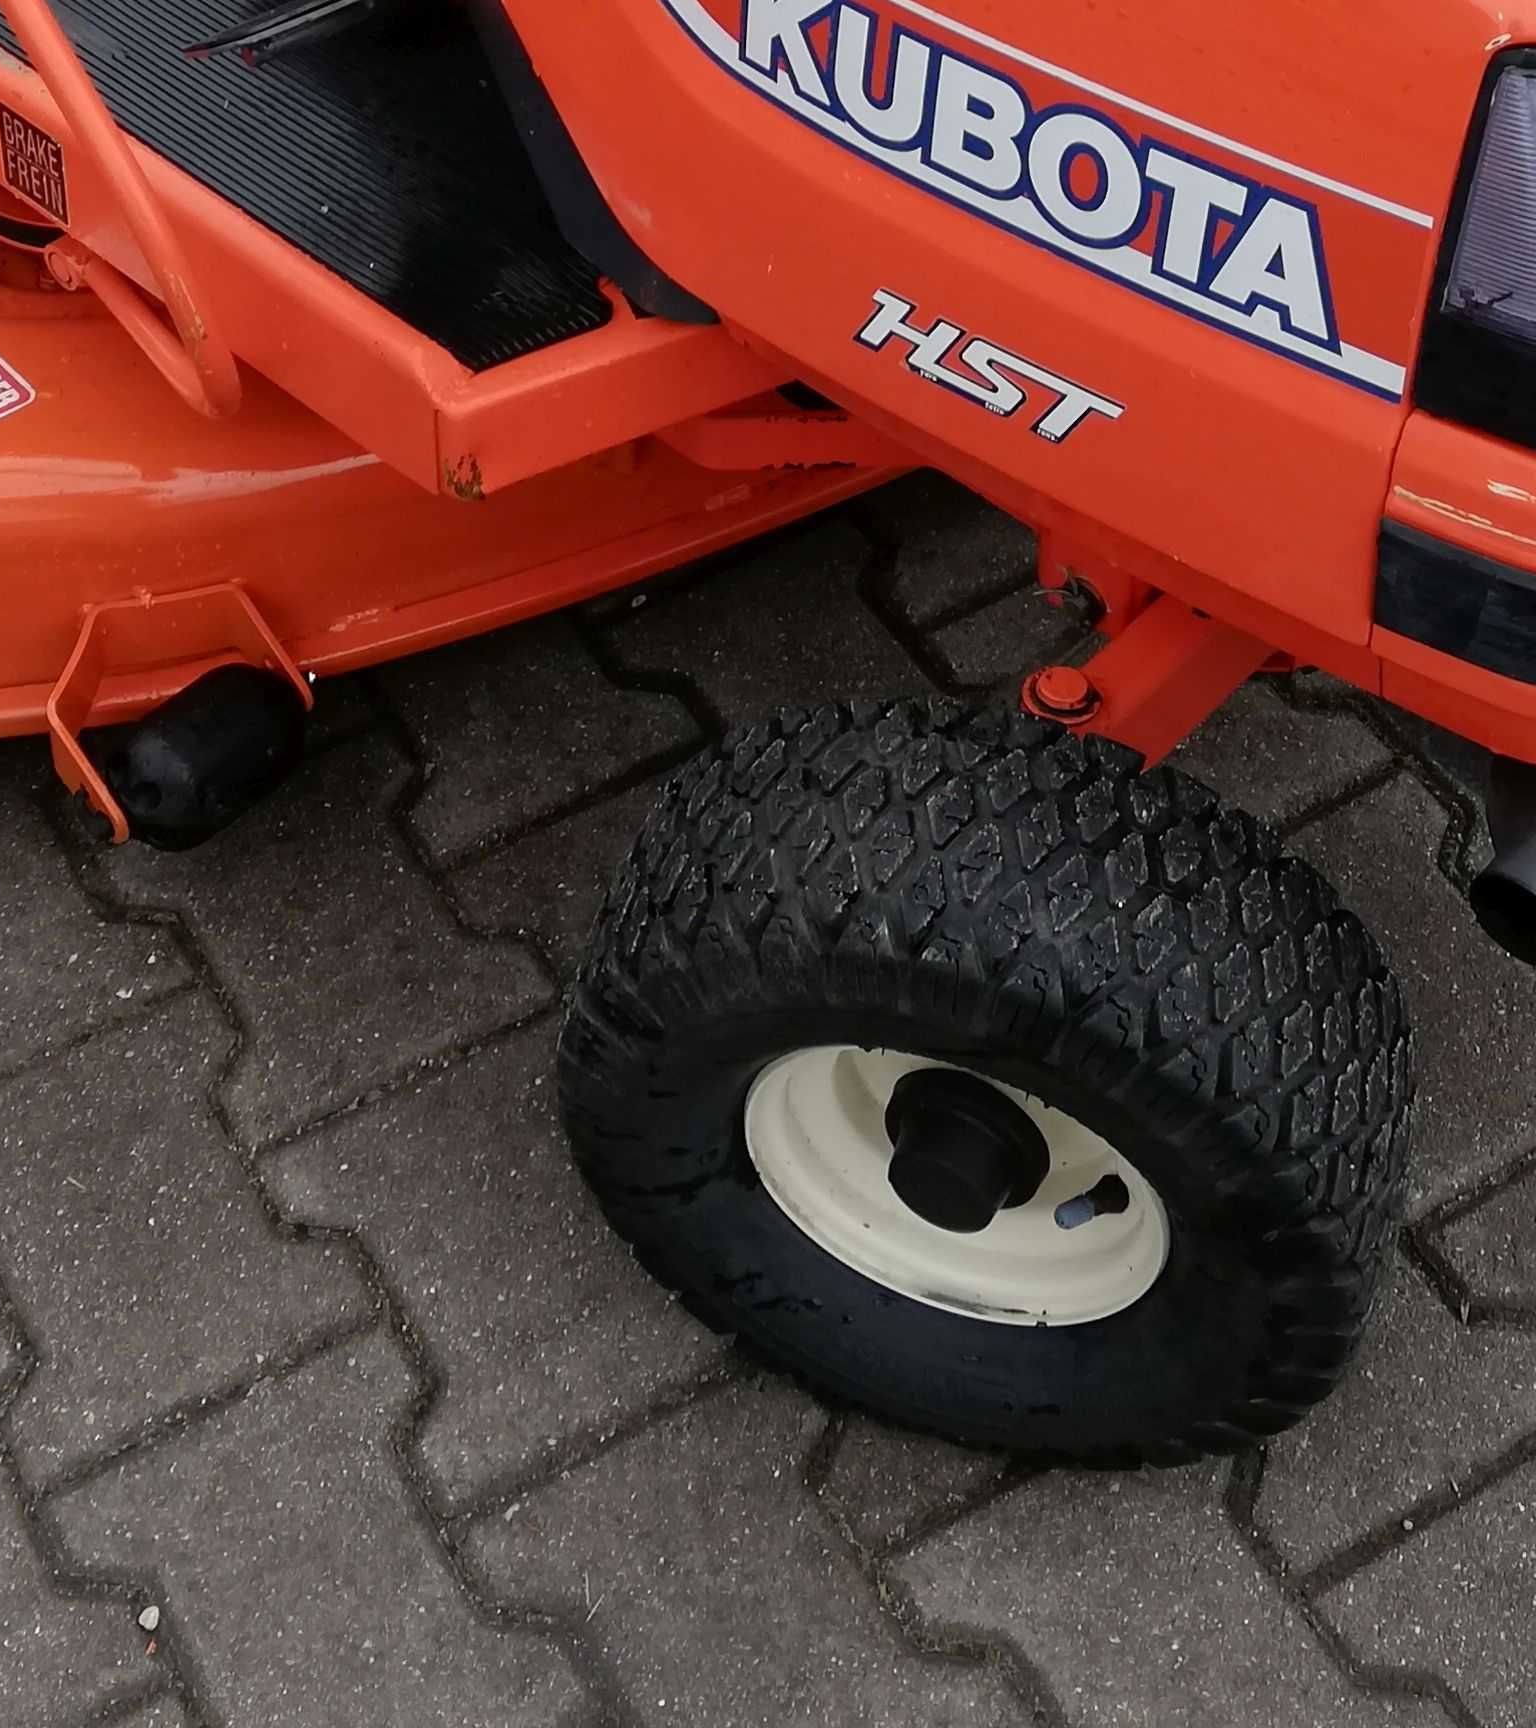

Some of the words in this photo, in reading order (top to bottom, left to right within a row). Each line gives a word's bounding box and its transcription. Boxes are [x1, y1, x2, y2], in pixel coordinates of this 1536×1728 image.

[2, 111, 59, 177] BRAKE
[7, 148, 64, 216] FREIN
[853, 287, 1126, 444] HST
